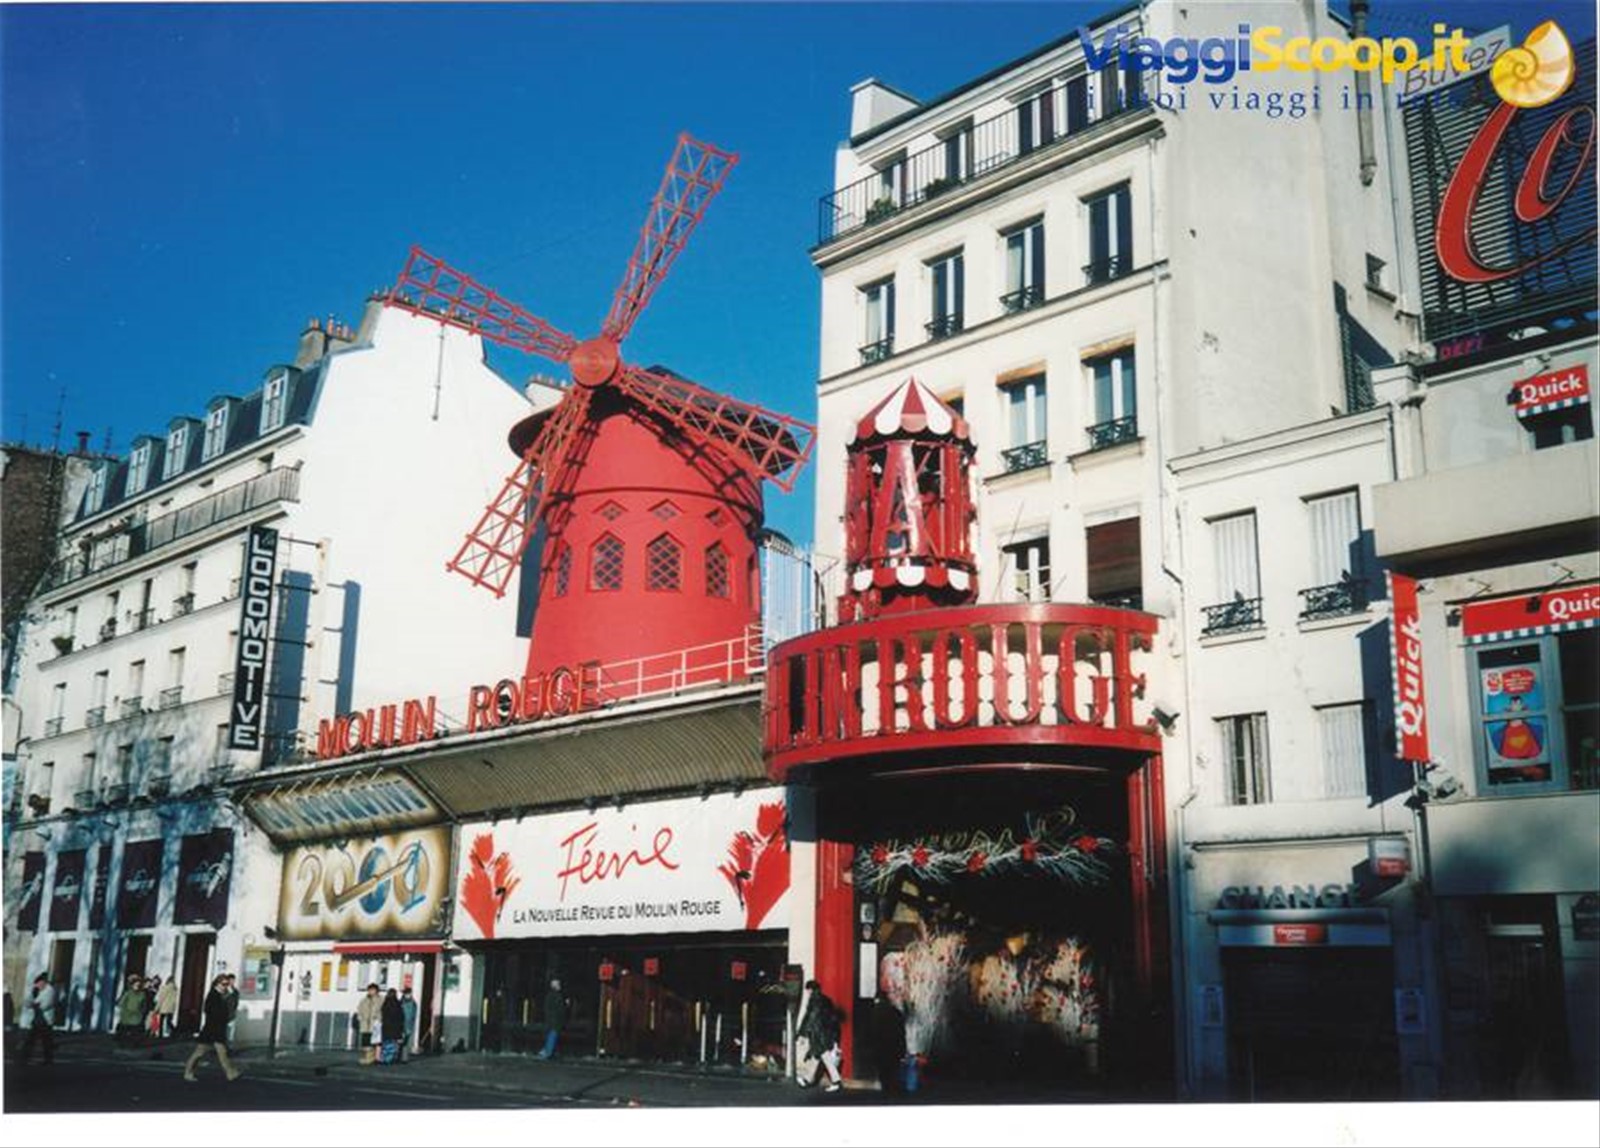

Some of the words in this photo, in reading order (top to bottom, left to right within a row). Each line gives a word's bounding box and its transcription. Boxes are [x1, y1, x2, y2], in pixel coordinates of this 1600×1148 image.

[1521, 374, 1582, 404] Quick
[233, 533, 273, 746] LOCOMOTIVE
[1399, 616, 1424, 736] Quick
[317, 696, 436, 758] MOULIN
[467, 659, 602, 732] ROUGE
[513, 909, 527, 924] LA
[528, 908, 579, 922] NOUVELLE
[580, 905, 616, 920] REVUE
[617, 905, 634, 919] DU
[635, 902, 679, 918] MOULIN
[681, 899, 722, 915] ROUGE
